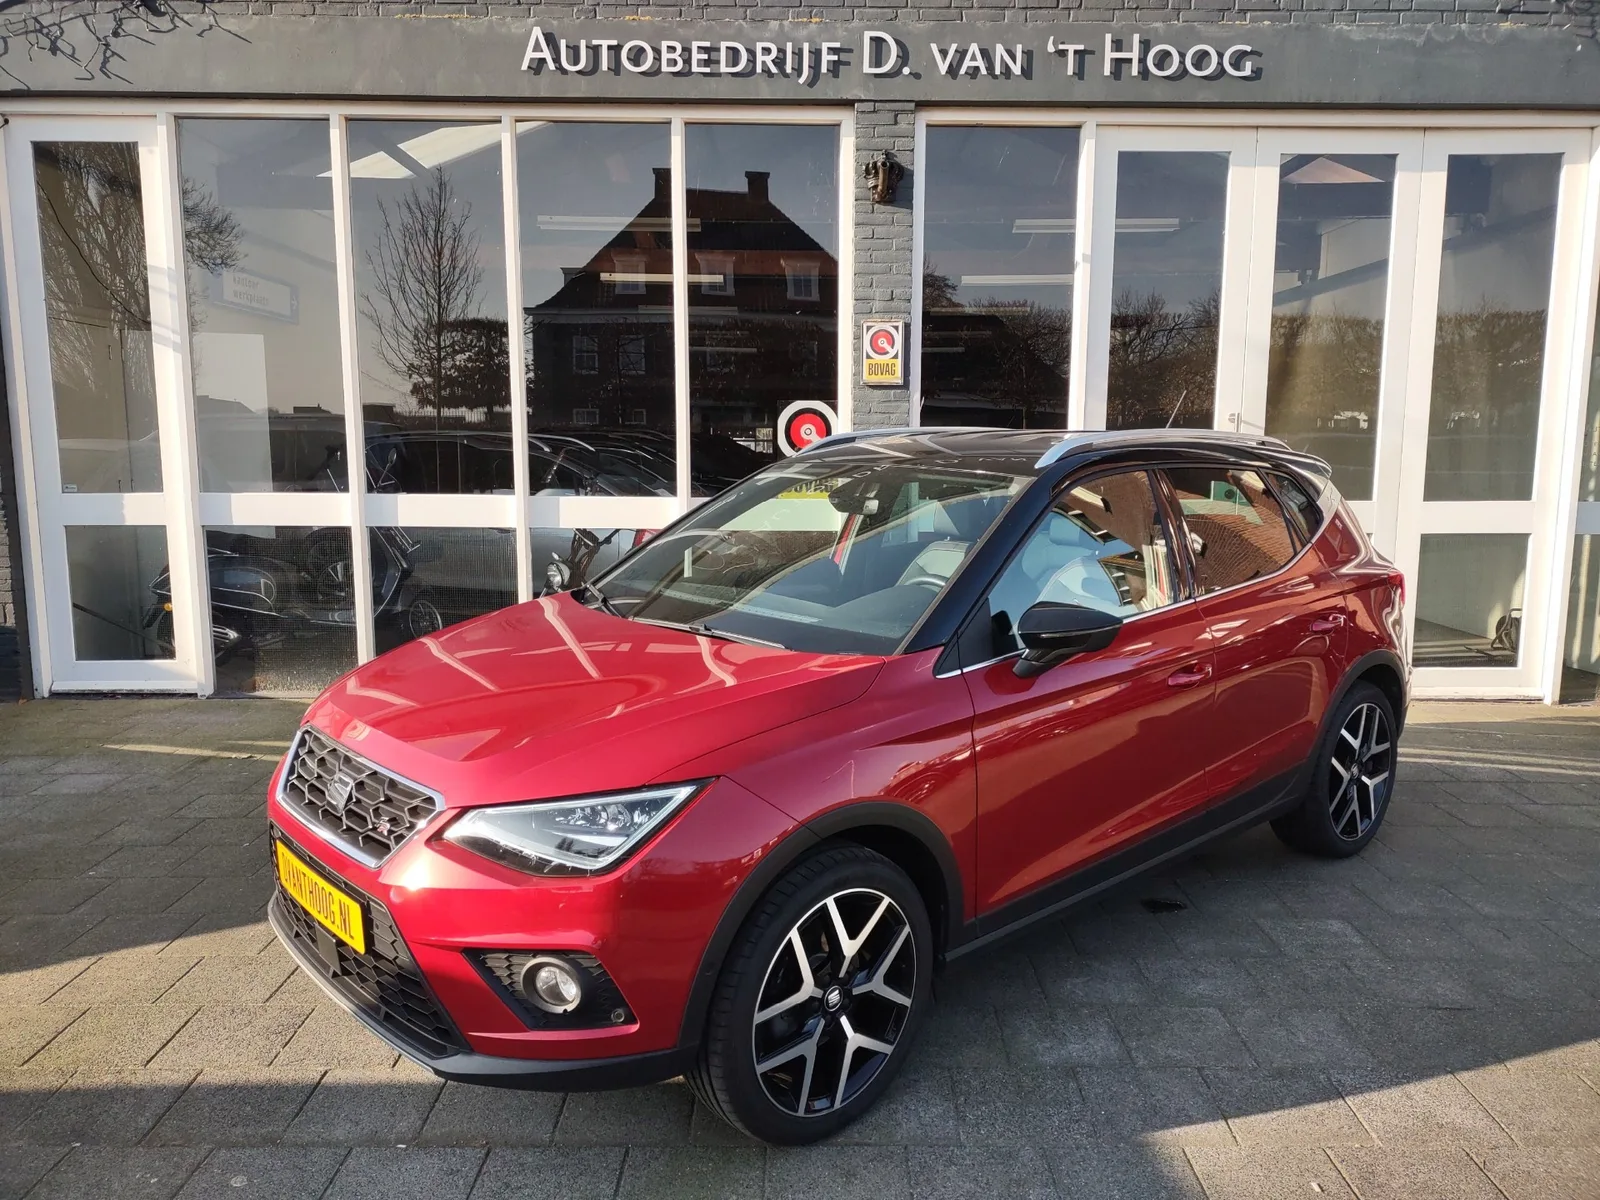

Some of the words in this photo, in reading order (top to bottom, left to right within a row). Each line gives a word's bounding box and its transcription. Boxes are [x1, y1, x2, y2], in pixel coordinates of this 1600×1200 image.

[520, 26, 841, 85] AUTOBEDRIJF
[862, 30, 911, 76] D.
[930, 42, 1022, 76] VAN
[1103, 33, 1253, 77] HOOG
[868, 363, 896, 376] BOVAG
